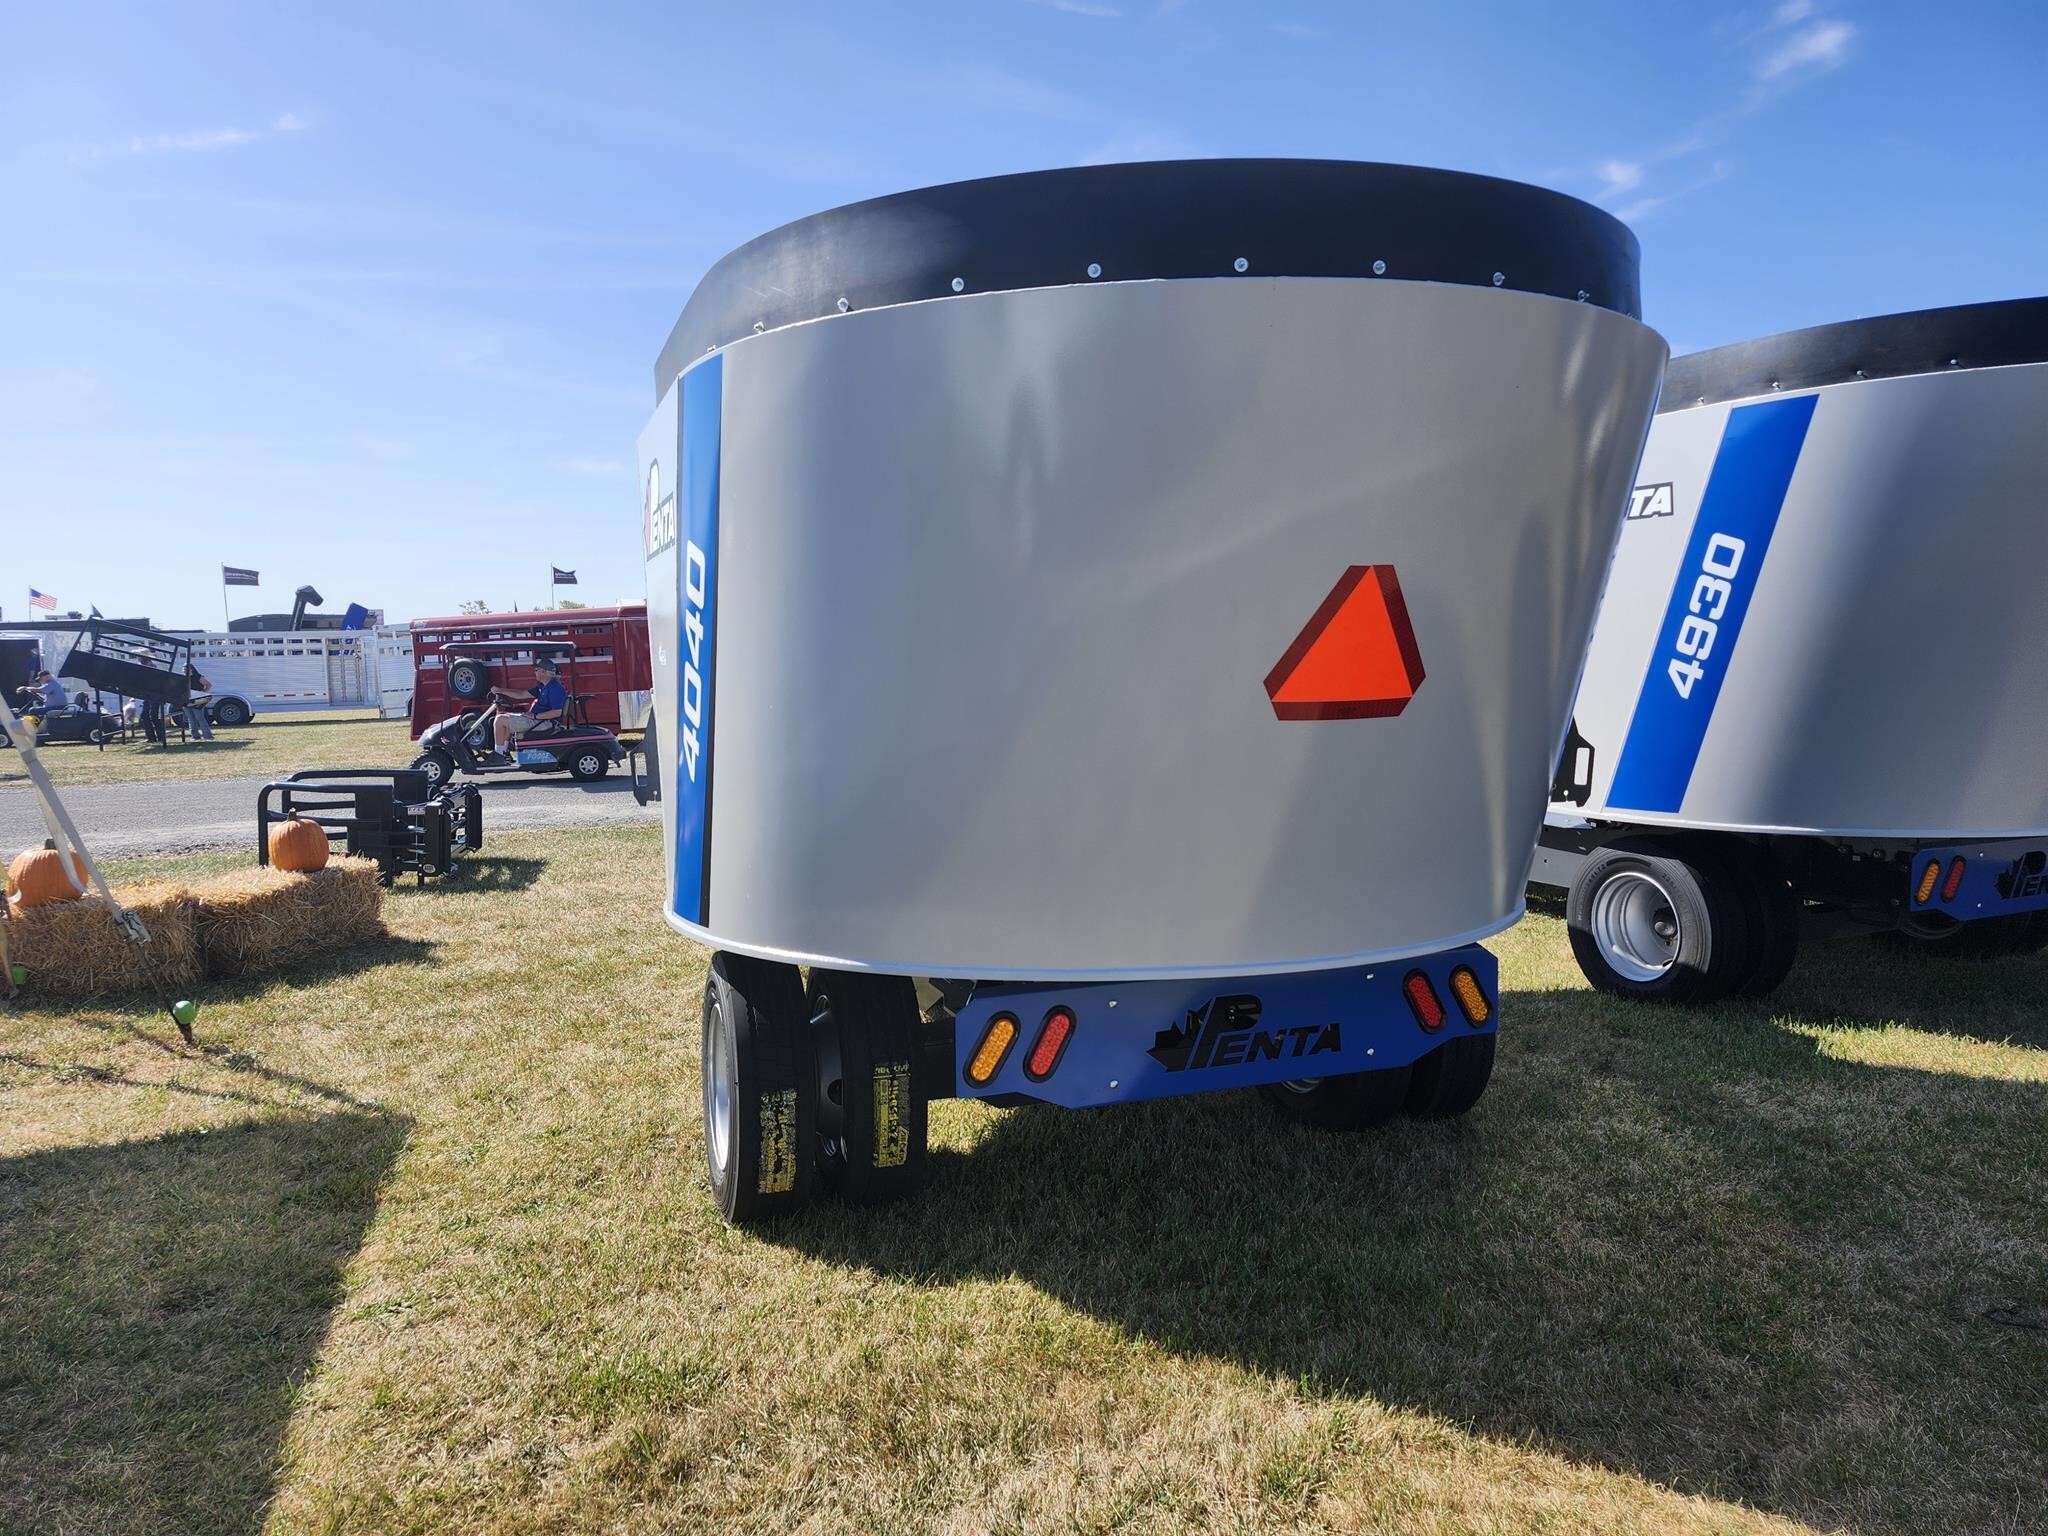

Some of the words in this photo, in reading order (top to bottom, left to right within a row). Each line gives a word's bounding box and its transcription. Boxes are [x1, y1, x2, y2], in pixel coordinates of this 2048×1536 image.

[1629, 484, 1673, 519] TA
[684, 539, 705, 783] 4040
[1667, 532, 1746, 699] 4930
[1189, 994, 1341, 1070] PENTA
